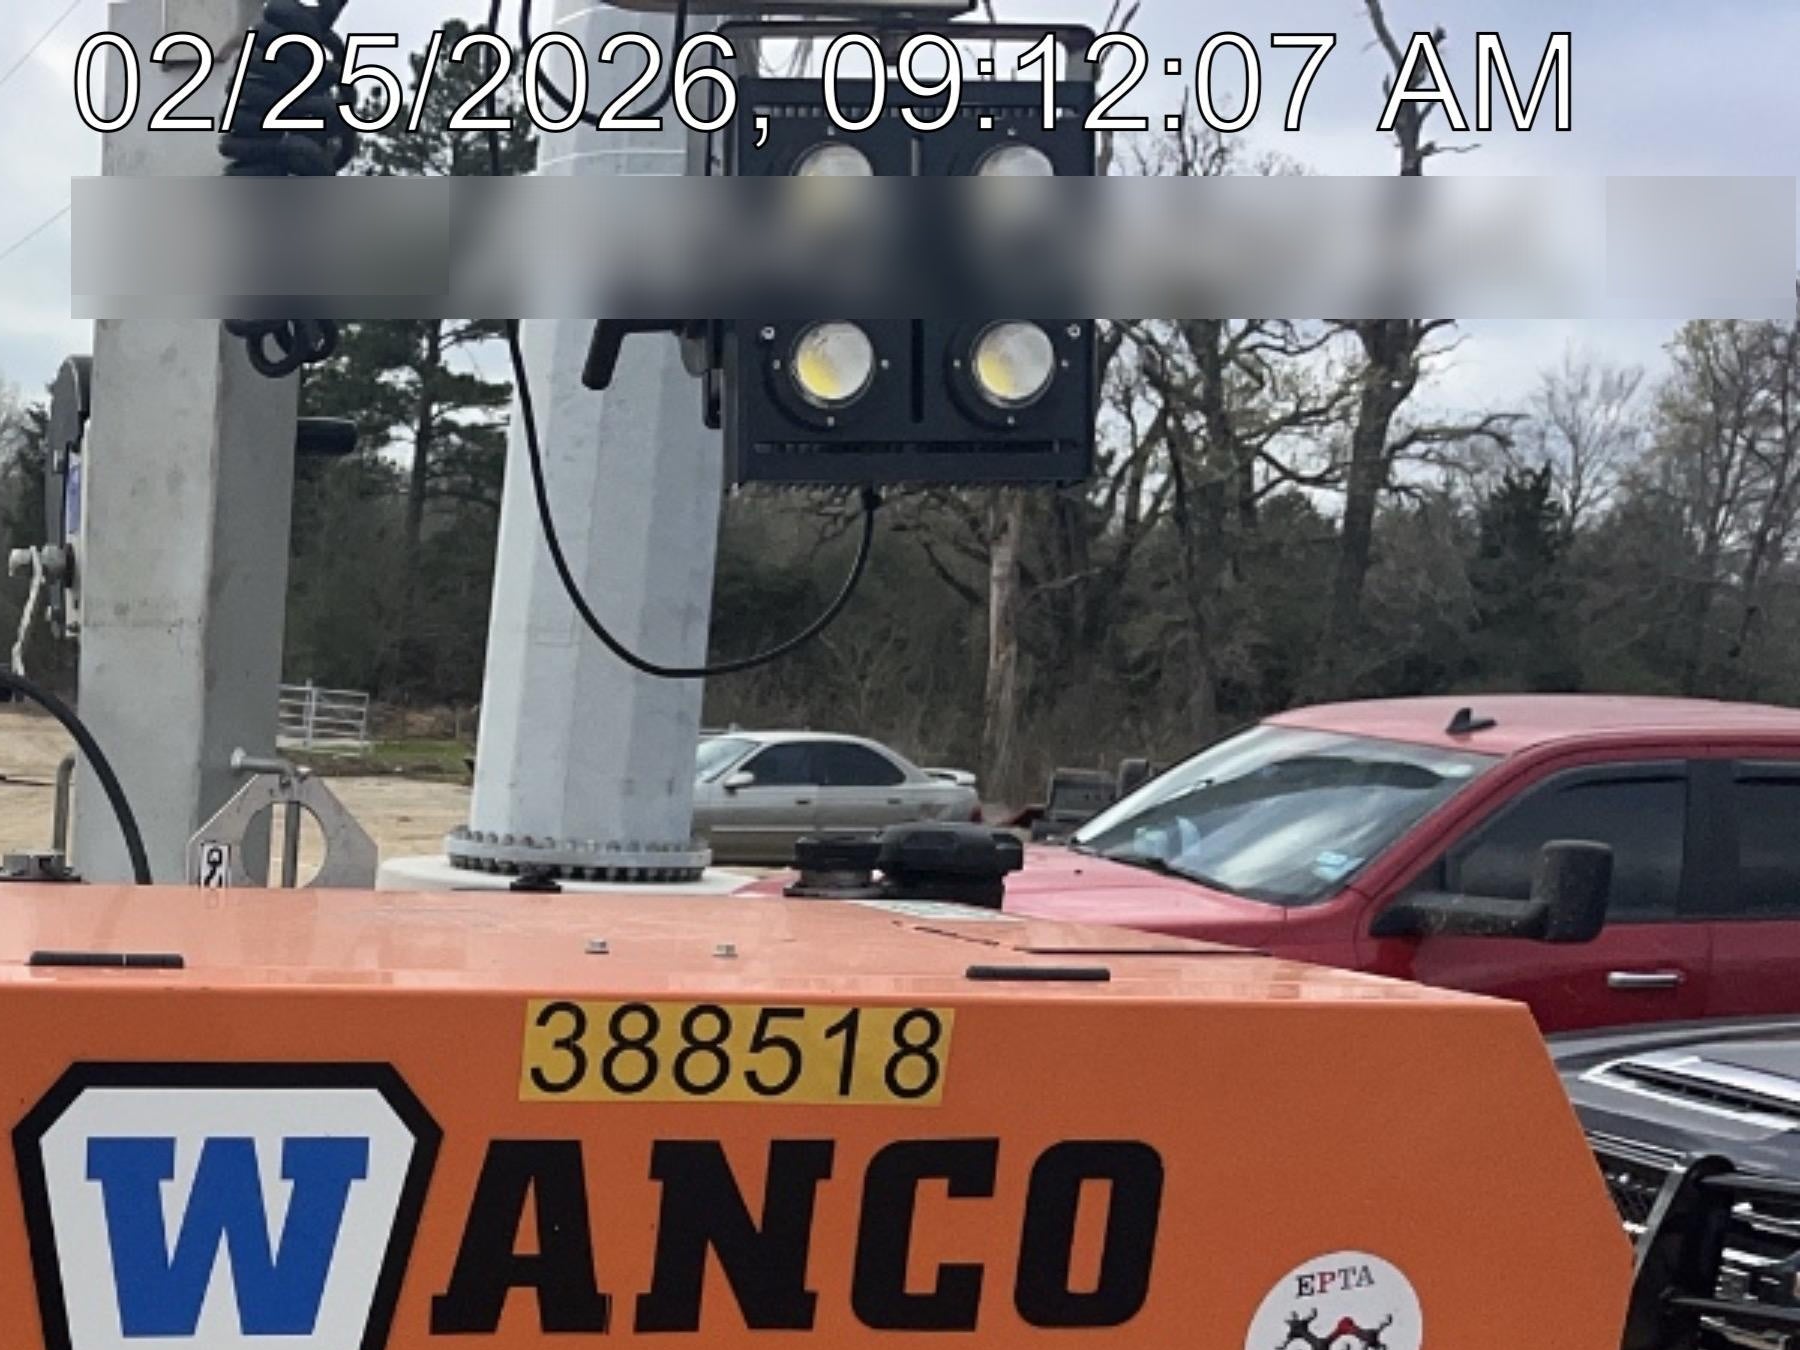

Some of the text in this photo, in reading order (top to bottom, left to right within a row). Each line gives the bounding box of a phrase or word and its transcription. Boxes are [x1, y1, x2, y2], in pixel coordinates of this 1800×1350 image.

[529, 1001, 943, 1099] 388518
[84, 1136, 1166, 1337] WANCO
[1295, 1264, 1376, 1299] EPTA
